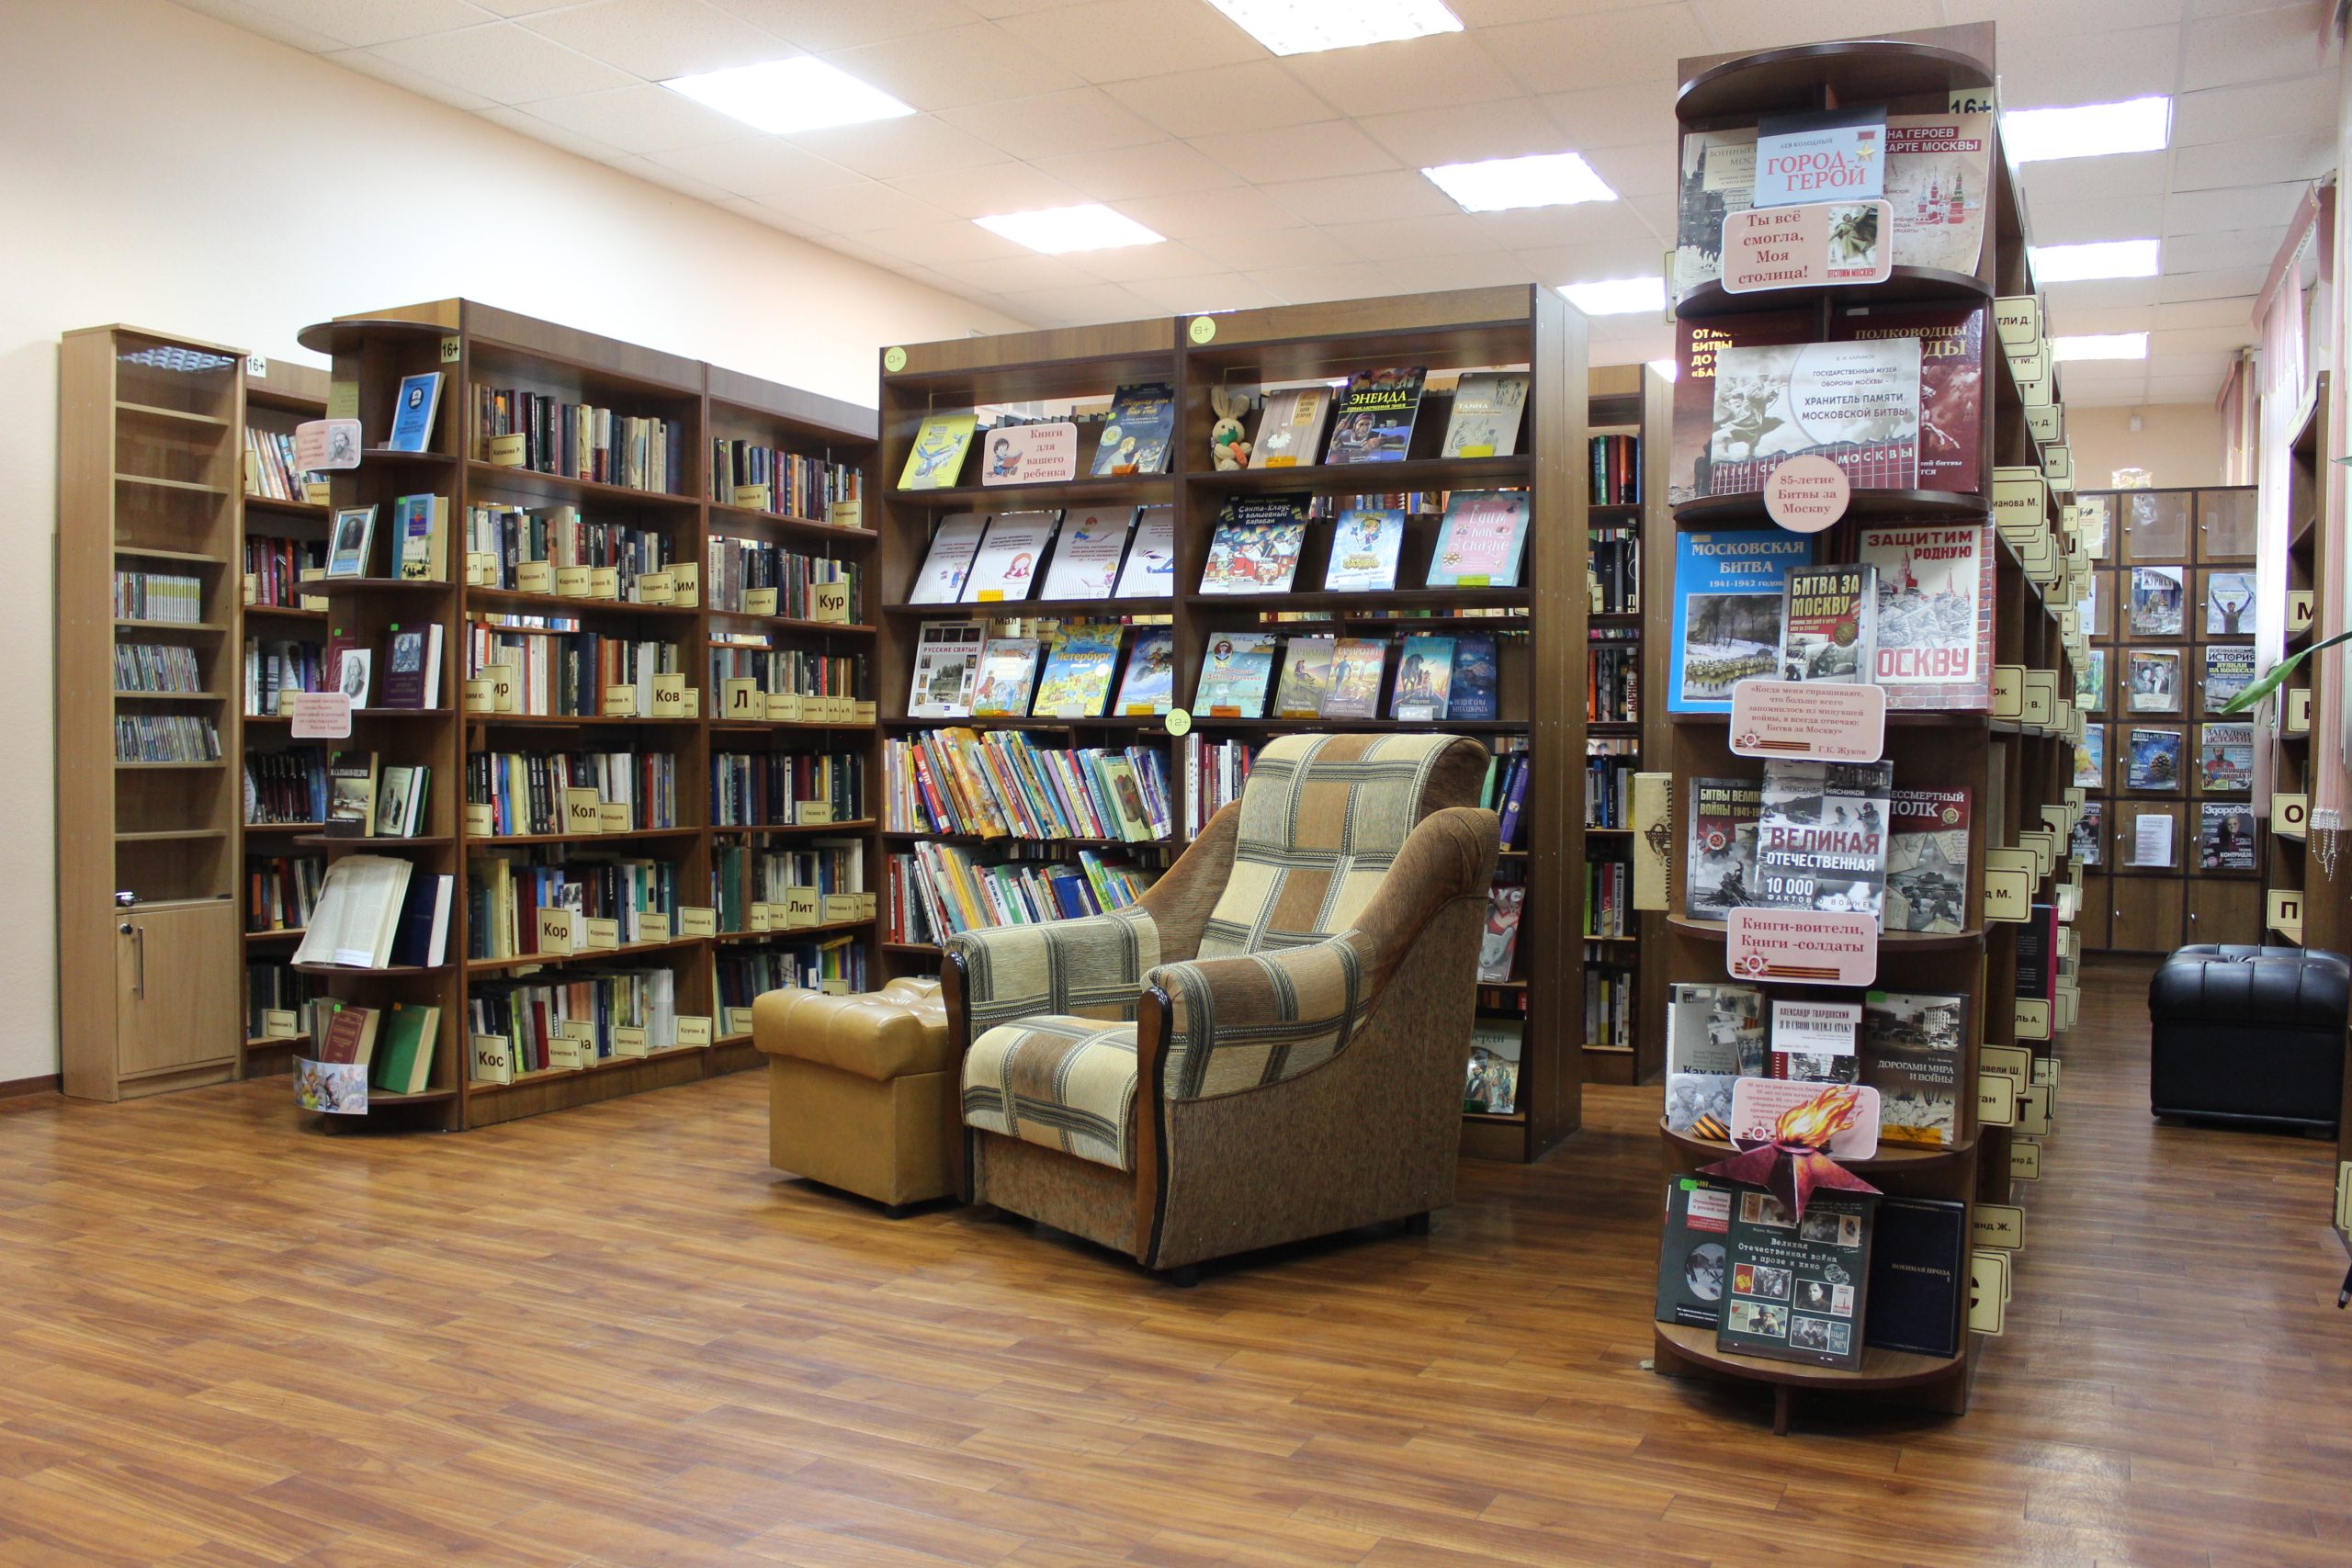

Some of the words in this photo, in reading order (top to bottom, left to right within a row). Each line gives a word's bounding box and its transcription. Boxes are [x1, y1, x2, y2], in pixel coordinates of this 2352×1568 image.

[1951, 98, 1992, 114] 16+
[1906, 128, 1954, 140] ГЕРОЕВ
[1921, 140, 1980, 152] МОСКВЫ
[1767, 151, 1855, 176] ГОРОД-
[1786, 166, 1865, 192] ГЕРОЙ
[1747, 214, 1772, 228] Ты
[1775, 209, 1802, 224] всё
[1743, 232, 1804, 247] смогла,
[1756, 250, 1790, 264] Моя
[1738, 265, 1809, 285] столица!
[2019, 316, 2031, 325] Д.
[1193, 324, 1211, 335] 6+
[1692, 329, 1710, 340] ОТ
[1855, 325, 1967, 340] ПОЛКОВОДЦЫ
[442, 342, 458, 357] 16+
[1691, 340, 1733, 352] БИТВЫ
[248, 357, 265, 371] 16+
[1691, 354, 1713, 367] ДО
[1813, 367, 1875, 377] ГОСУДАРСТВЕННЫЙ
[1876, 366, 1897, 374] МУЗЕЙ
[1855, 378, 1883, 386] МОСКВЫ
[1349, 390, 1407, 405] ЭНЕИДА
[1804, 395, 1860, 406] ХРАНИТЕЛЬ
[1862, 393, 1904, 404] ПАМЯТИ
[1802, 408, 1871, 421] МОСКОВСКОЙ
[1873, 407, 1908, 418] БИТВЫ
[1030, 428, 1064, 440] Книги
[1035, 441, 1056, 453] для
[1025, 455, 1065, 466] вашего
[1838, 448, 1913, 465] МОСКВЫ
[1023, 467, 1067, 480] ребенка
[1780, 475, 1836, 487] 85-летие
[1778, 490, 1819, 500] Битвы
[1822, 491, 1837, 500] за
[2027, 497, 2039, 507] М.
[1238, 504, 1291, 513] Санта-Клаус
[1782, 503, 1831, 515] Москву
[1868, 530, 1973, 547] ЗАЩИТИМ
[1691, 540, 1804, 557] МОСКОВСКАЯ
[1914, 545, 1972, 559] РОДНУЮ
[1719, 560, 1774, 574] БИТВА
[1709, 580, 1756, 588] 1941-1942
[1792, 576, 1837, 596] БИТВА
[1840, 574, 1860, 594] ЗА
[820, 594, 844, 611] Кур
[1791, 595, 1850, 617] МОСКВУ
[1056, 650, 1111, 664] Петербург
[1876, 647, 1970, 678] ОСКВУ
[2208, 653, 2256, 661] ИСТОРИЯ
[656, 689, 680, 703] Ков
[734, 689, 748, 708] Л
[1627, 680, 1637, 713] БАРНС
[1785, 696, 1818, 705] больше
[1819, 699, 1844, 707] всего
[1748, 705, 1804, 714] запомнилось
[1818, 709, 1864, 717] минувшей
[2030, 700, 2041, 709] В.
[1166, 717, 1190, 728] 12+
[1791, 716, 1818, 725] всегда
[1767, 724, 1792, 732] Битва
[2205, 728, 2251, 737] ЗАГАДКИ
[1837, 746, 1867, 756] Жуков
[1701, 788, 1730, 802] БИТВЫ
[1779, 785, 1822, 794] АЛЕКСАНДР
[1825, 788, 1866, 796] МЯСНИКОВ
[1890, 791, 1965, 803] ЕССМЕРТНЫЙ
[571, 804, 596, 818] Кол
[1700, 802, 1732, 817] ВОЙНЫ
[1889, 801, 1939, 818] ПОЛК
[2205, 806, 2254, 816] Здоровье
[2284, 805, 2304, 823] О
[1770, 827, 1881, 855] ВЕЛИКАЯ
[1766, 852, 1876, 872] ОТЕЧЕСТВЕННАЯ
[1766, 876, 1782, 895] 10
[1783, 878, 1815, 896] 000
[1767, 894, 1813, 904] ФАКТОВ
[1830, 897, 1870, 908] ВОЙНЕ
[1996, 889, 2012, 899] М.
[789, 900, 814, 913] Лит
[2280, 901, 2298, 919] П
[544, 922, 568, 941] Кор
[1742, 917, 1865, 938] Книги-воители,
[1741, 935, 1789, 950] Книги
[1792, 938, 1864, 954] -солдаты
[1780, 1007, 1811, 1018] АЛЕКСАНДР
[1812, 1009, 1849, 1020] ТВАРДОВСКИЙ
[1791, 1021, 1810, 1032] СВОЮ
[479, 1050, 504, 1067] Кос
[1877, 1060, 1927, 1072] ДОРОГАМИ
[1928, 1065, 1954, 1075] МИРА
[2009, 1065, 2021, 1076] Ш.
[1909, 1072, 1917, 1081] И
[1918, 1073, 1953, 1084] ВОЙНЫ
[1996, 1222, 2011, 1232] Ж.
[1770, 1237, 1809, 1250] Великая
[1738, 1242, 1807, 1258] Отечественная
[1811, 1252, 1838, 1263] война
[1760, 1256, 1786, 1267] прозе
[1798, 1260, 1820, 1271] кино
